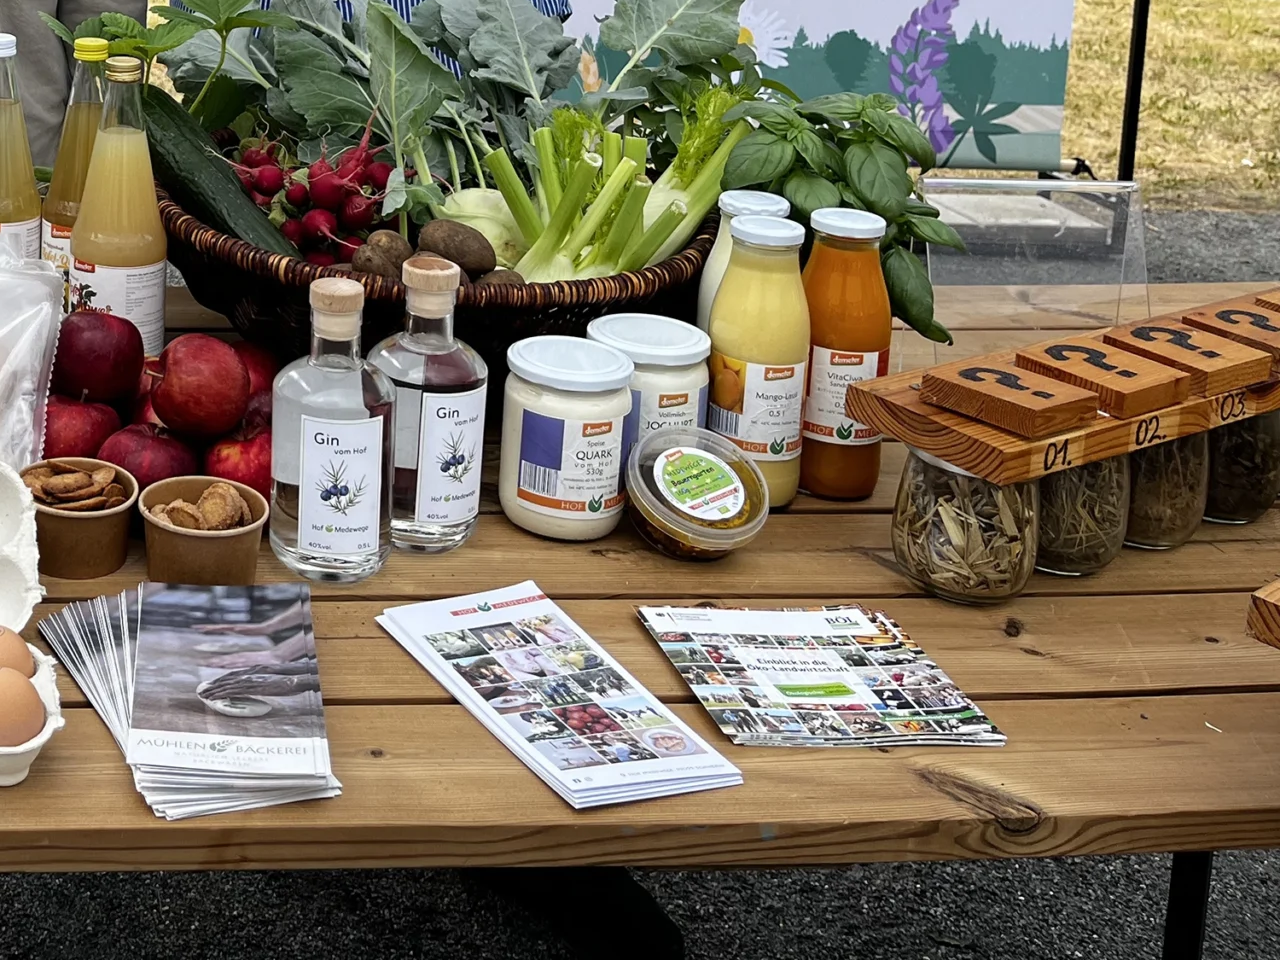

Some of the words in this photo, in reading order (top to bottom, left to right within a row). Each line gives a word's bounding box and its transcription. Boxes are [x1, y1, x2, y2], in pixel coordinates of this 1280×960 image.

[832, 355, 860, 363] demeter
[767, 370, 792, 379] demeter
[661, 397, 686, 406] demeter
[1220, 392, 1246, 422] 03.
[436, 406, 460, 420] Gin
[454, 419, 469, 427] vom
[469, 414, 479, 423] Hof
[585, 425, 610, 435] demeter
[809, 424, 831, 435] HOF
[1136, 415, 1167, 446] 02.
[314, 432, 340, 447] Gin
[587, 440, 606, 448] Speise
[353, 446, 368, 455] Hof
[742, 442, 765, 451] HOF
[575, 449, 613, 461] QUARK
[1043, 438, 1073, 471] 01.
[586, 467, 604, 476] 530g
[430, 495, 442, 503] Hof
[561, 502, 584, 511] HOF
[312, 523, 324, 532] Hof
[334, 524, 369, 533] Medewege
[756, 658, 798, 667] Einblick
[799, 658, 810, 667] in
[811, 658, 828, 666] die
[746, 664, 851, 674] Öko-Landwirtschaft
[136, 737, 206, 751] MÜHLEN
[236, 745, 307, 755] BÄCKEREI
